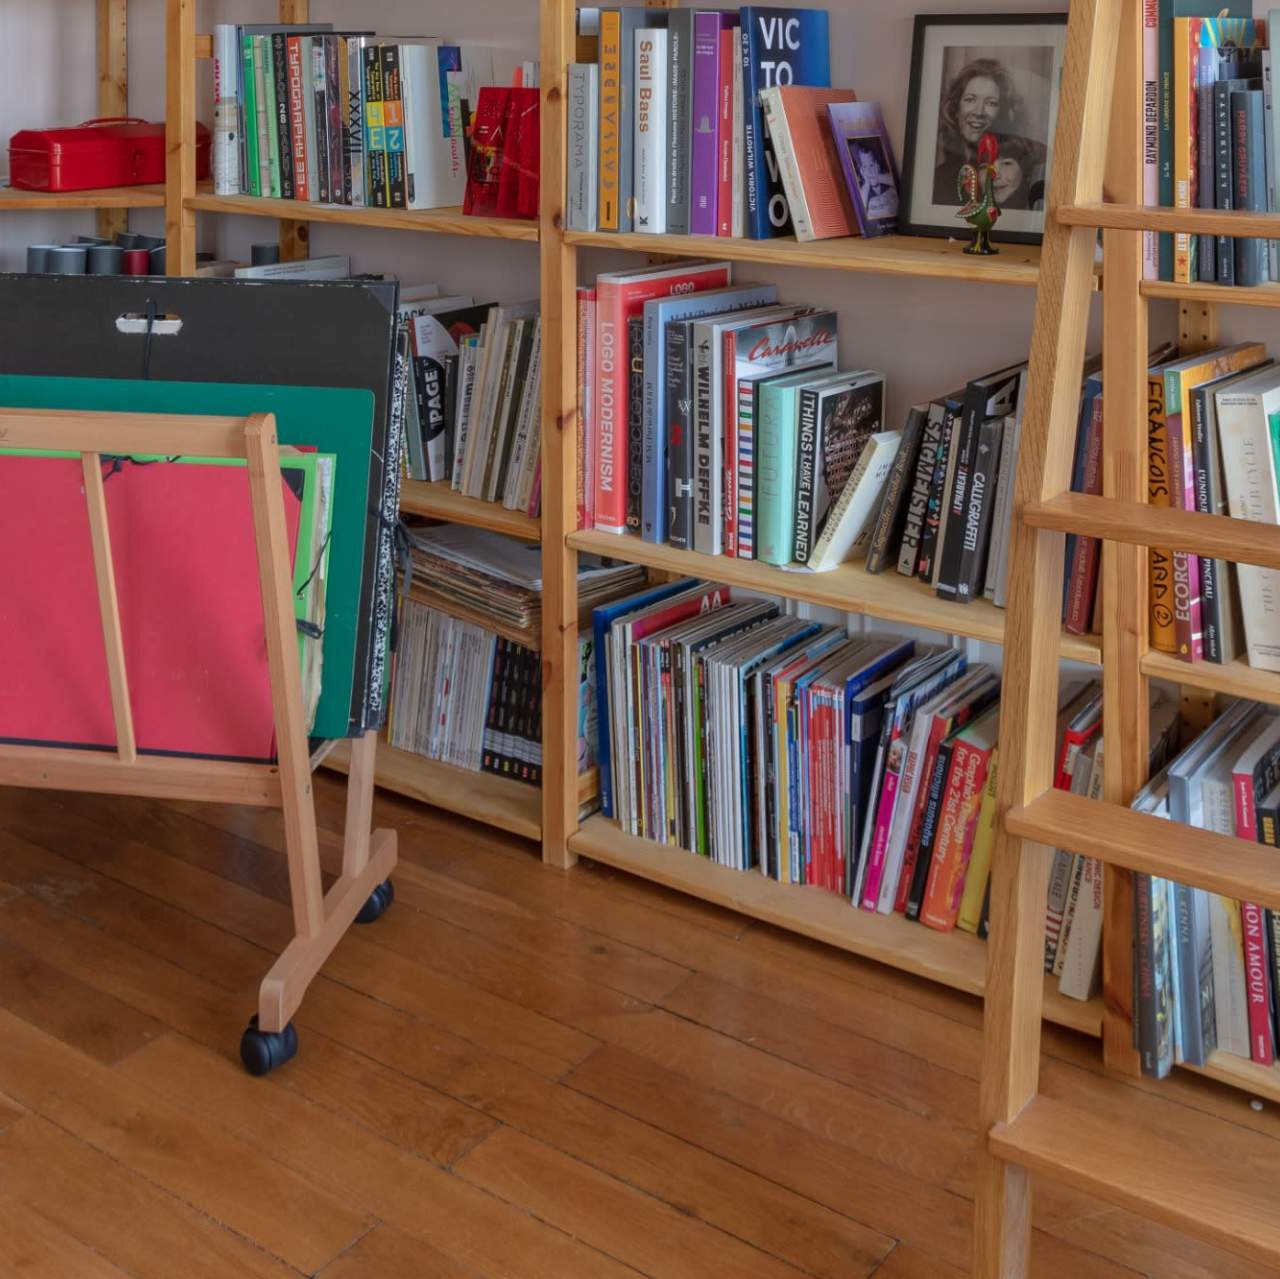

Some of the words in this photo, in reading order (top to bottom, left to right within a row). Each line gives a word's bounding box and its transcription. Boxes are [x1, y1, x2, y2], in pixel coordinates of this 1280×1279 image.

[759, 16, 801, 50] VIC
[639, 41, 653, 80] Saul
[760, 61, 793, 87] TO
[279, 103, 288, 124] 28
[289, 43, 304, 157] TYPOGRAPHY
[572, 73, 586, 169] TYPORAMA
[603, 44, 616, 190] CASSANDRE
[638, 88, 652, 132] Bass
[1145, 80, 1158, 122] DEPARDON
[745, 125, 754, 168] WILMOTTE
[1145, 126, 1157, 164] RAYMOND
[295, 160, 304, 184] 33
[747, 172, 755, 212] VICTORIA
[669, 283, 693, 294] LOGO
[598, 322, 615, 373] LOGO
[424, 369, 443, 422] PAGE
[697, 367, 711, 449] WILHELM
[599, 379, 616, 492] MODERNISM
[1143, 380, 1168, 497] FRANCOIS
[697, 454, 711, 525] DEFFKE
[900, 417, 941, 551] SAGMEISTER
[795, 491, 810, 562] LEARNED
[963, 472, 985, 552] CALLIGRAFFITI
[1200, 557, 1216, 600] PINCEAU
[950, 766, 961, 787] the
[955, 747, 965, 765] for
[961, 752, 979, 799] Graphic
[947, 788, 958, 813] 21st
[955, 800, 971, 845] Design
[936, 814, 954, 863] Century
[1247, 940, 1265, 1004] AMOUR
